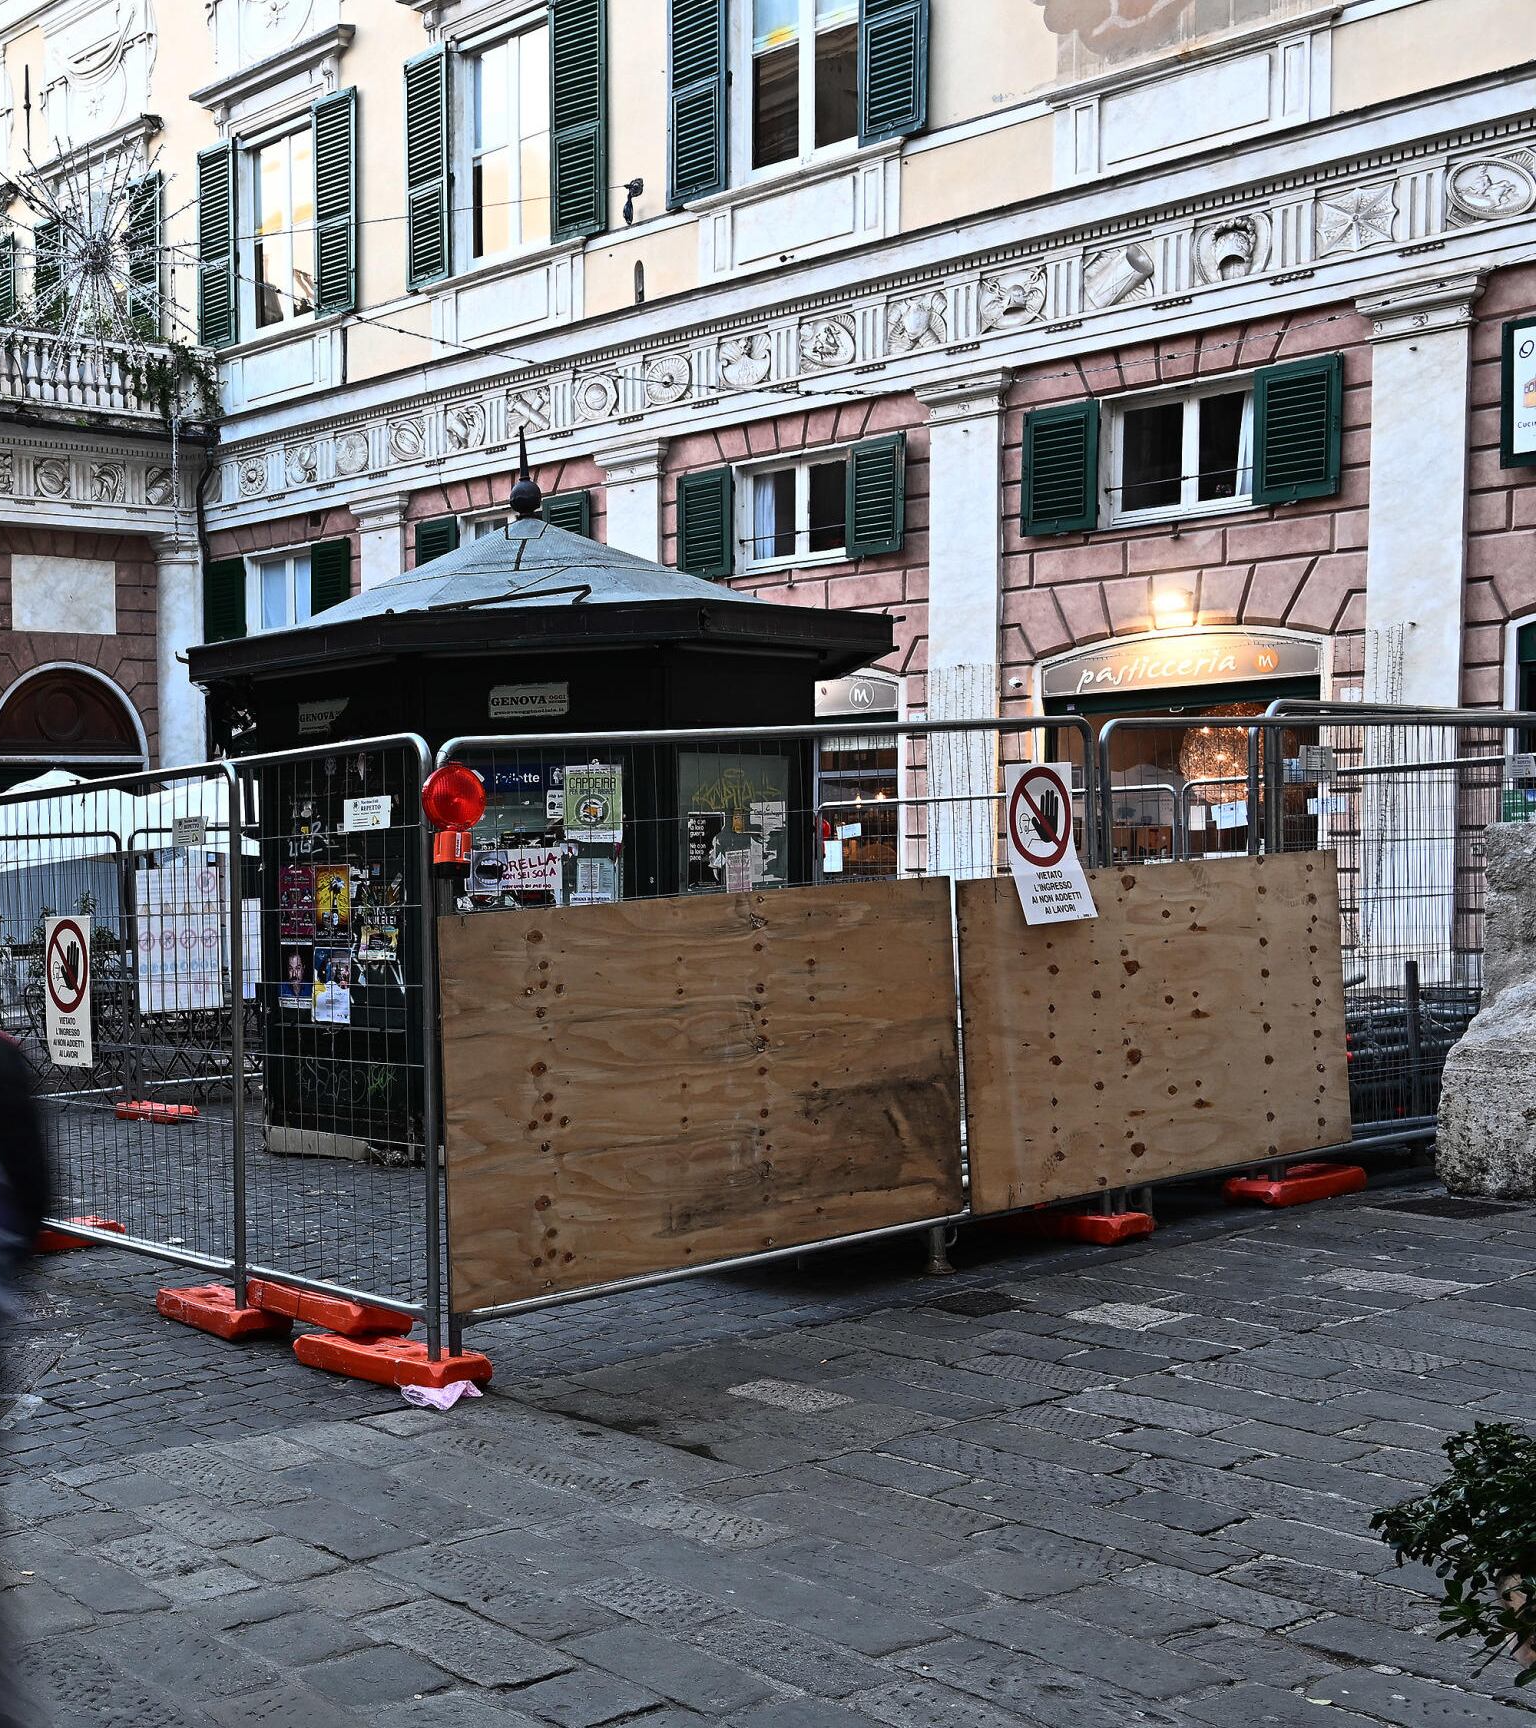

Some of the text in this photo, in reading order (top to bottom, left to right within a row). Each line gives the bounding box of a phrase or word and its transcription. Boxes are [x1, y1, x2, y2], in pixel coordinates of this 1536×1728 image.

[1075, 651, 1238, 694] pasticceria
[490, 695, 547, 707] GENOVA
[299, 711, 335, 723] GENOVA
[569, 777, 617, 789] CAPOEIRA
[517, 871, 530, 880] SEI
[532, 867, 557, 879] SOLA
[1036, 870, 1063, 880] VIETATO
[1033, 880, 1073, 893] L'INGRESSO
[1031, 891, 1083, 905] AI NON ADDETTI
[1044, 903, 1077, 915] AI LAVORI
[58, 1016, 76, 1026] VIETATO
[55, 1027, 81, 1037] L'INGRESSO
[52, 1038, 85, 1048] AI NON ADDETTI
[58, 1050, 79, 1059] AI LAVORI
